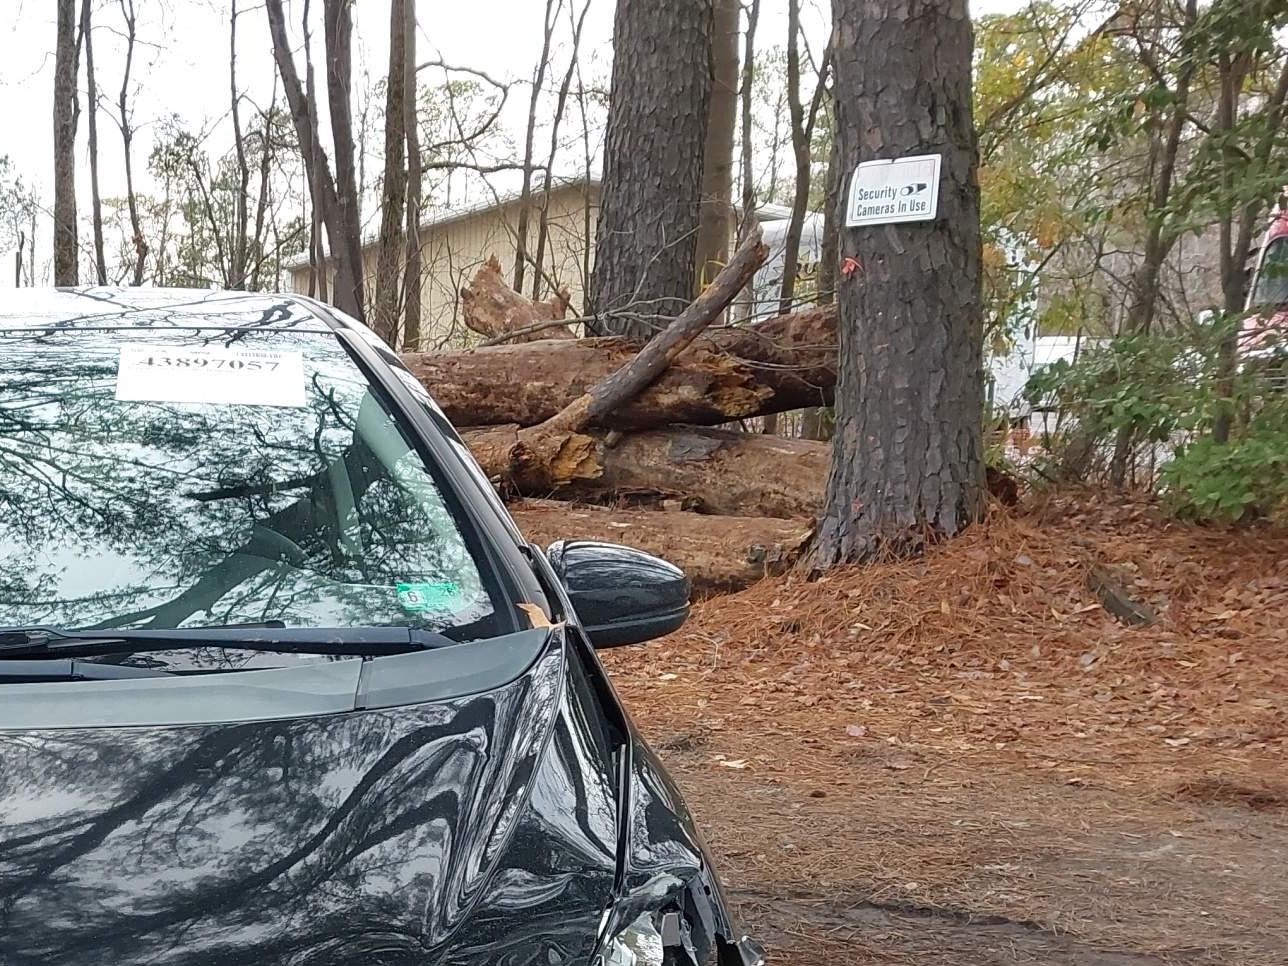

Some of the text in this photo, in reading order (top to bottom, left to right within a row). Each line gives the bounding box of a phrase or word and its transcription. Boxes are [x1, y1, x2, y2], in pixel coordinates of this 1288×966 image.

[858, 186, 898, 201] Security
[856, 199, 927, 217] Cameras In Use
[136, 356, 280, 372] 43897057
[407, 591, 418, 603] 6
